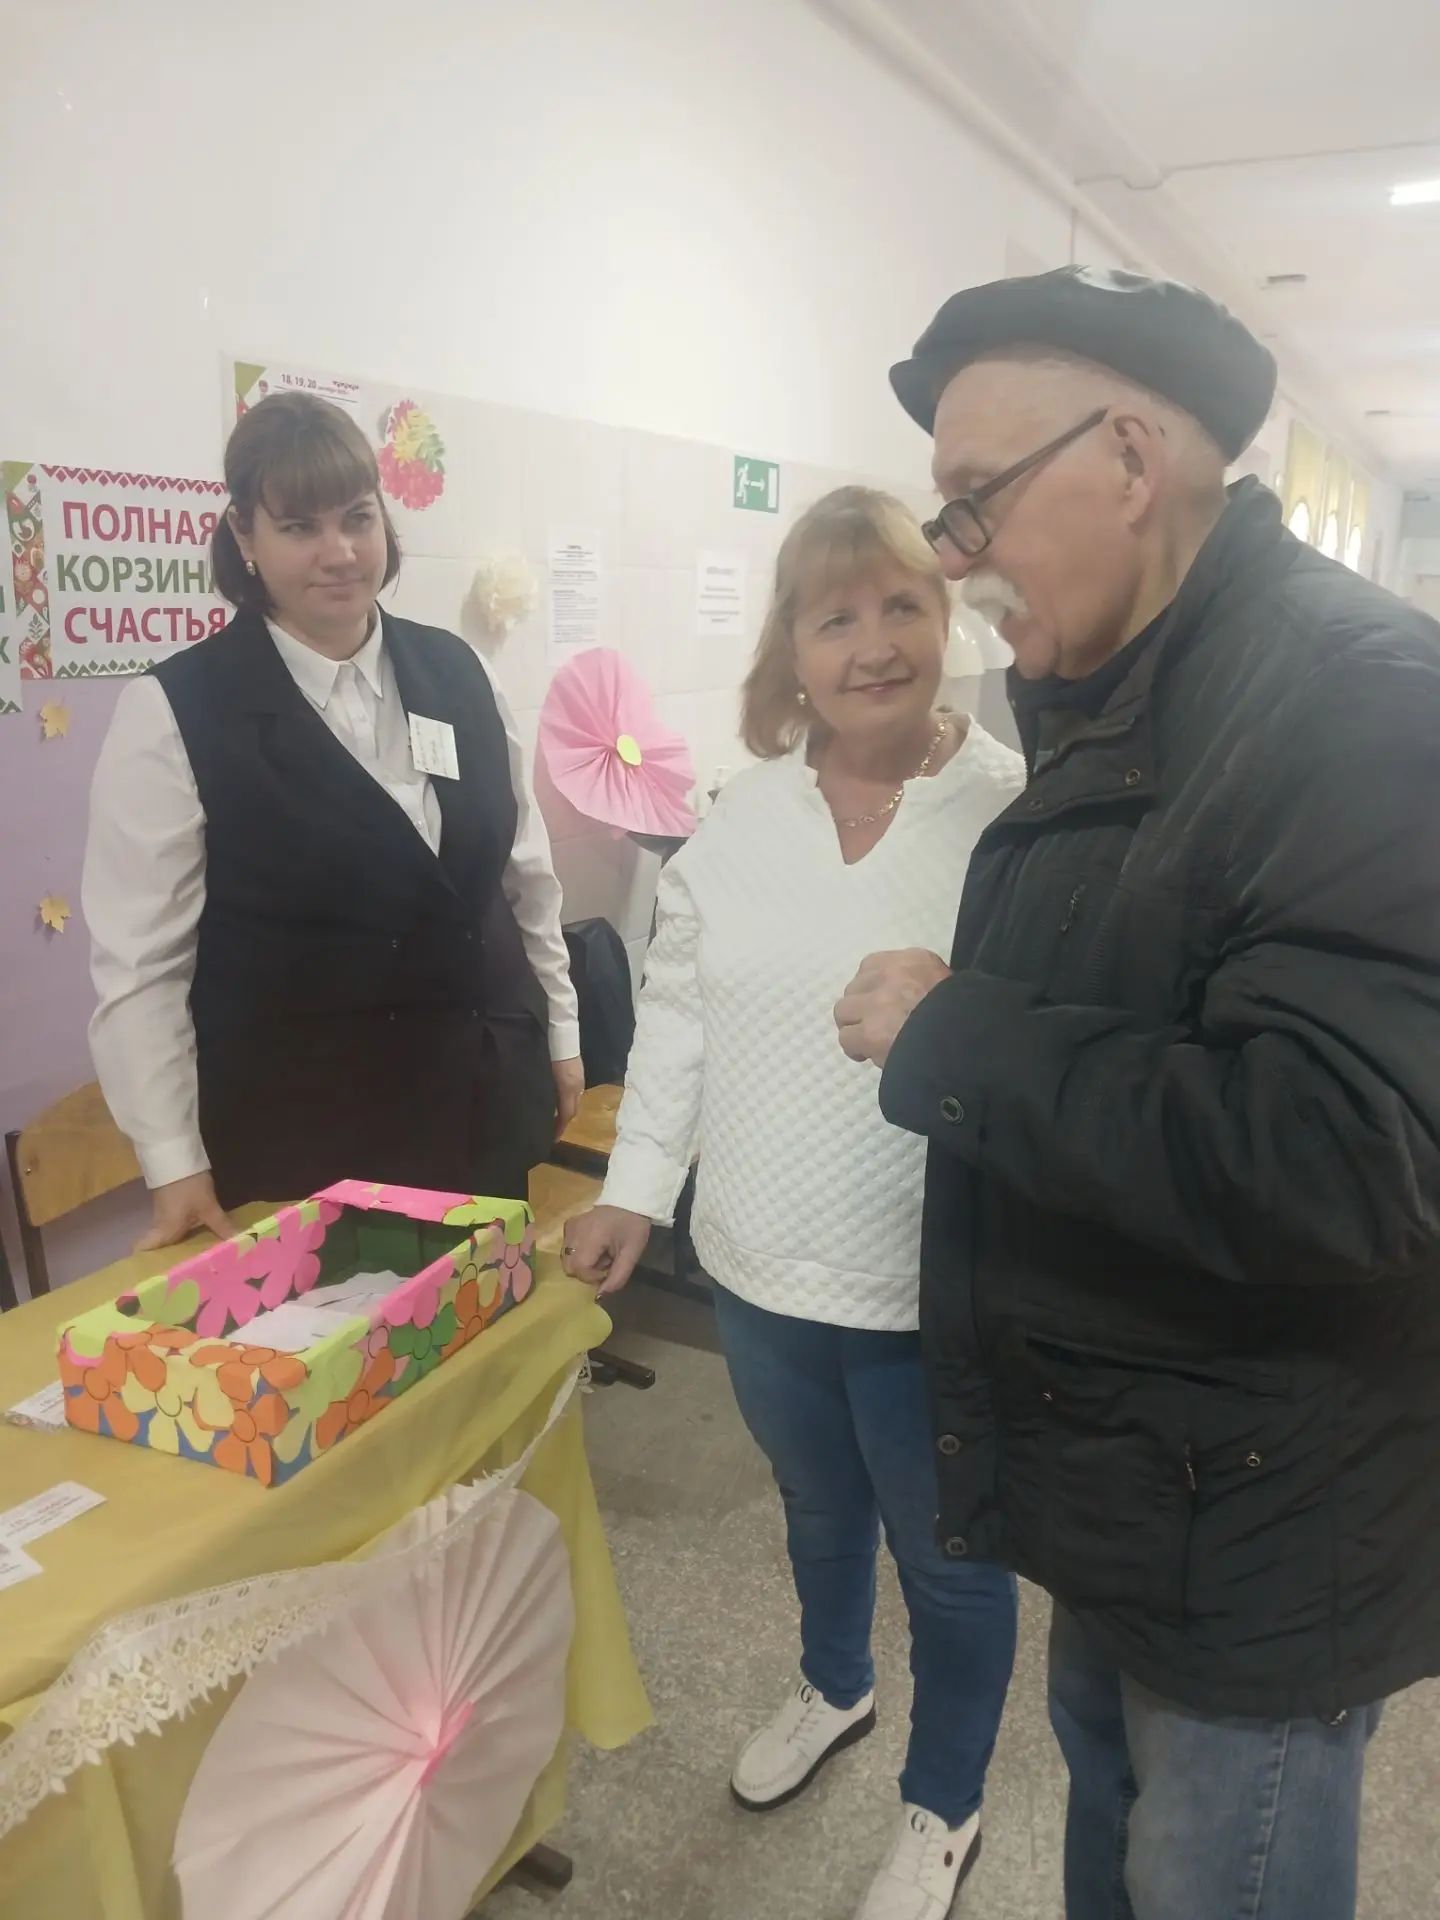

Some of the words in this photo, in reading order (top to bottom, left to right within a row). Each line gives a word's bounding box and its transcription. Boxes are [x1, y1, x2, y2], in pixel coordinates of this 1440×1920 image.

[63, 501, 217, 546] ПОЛНАЯ
[56, 554, 216, 594] КОРЗИН
[64, 606, 226, 644] СЧАСТЬЯ
